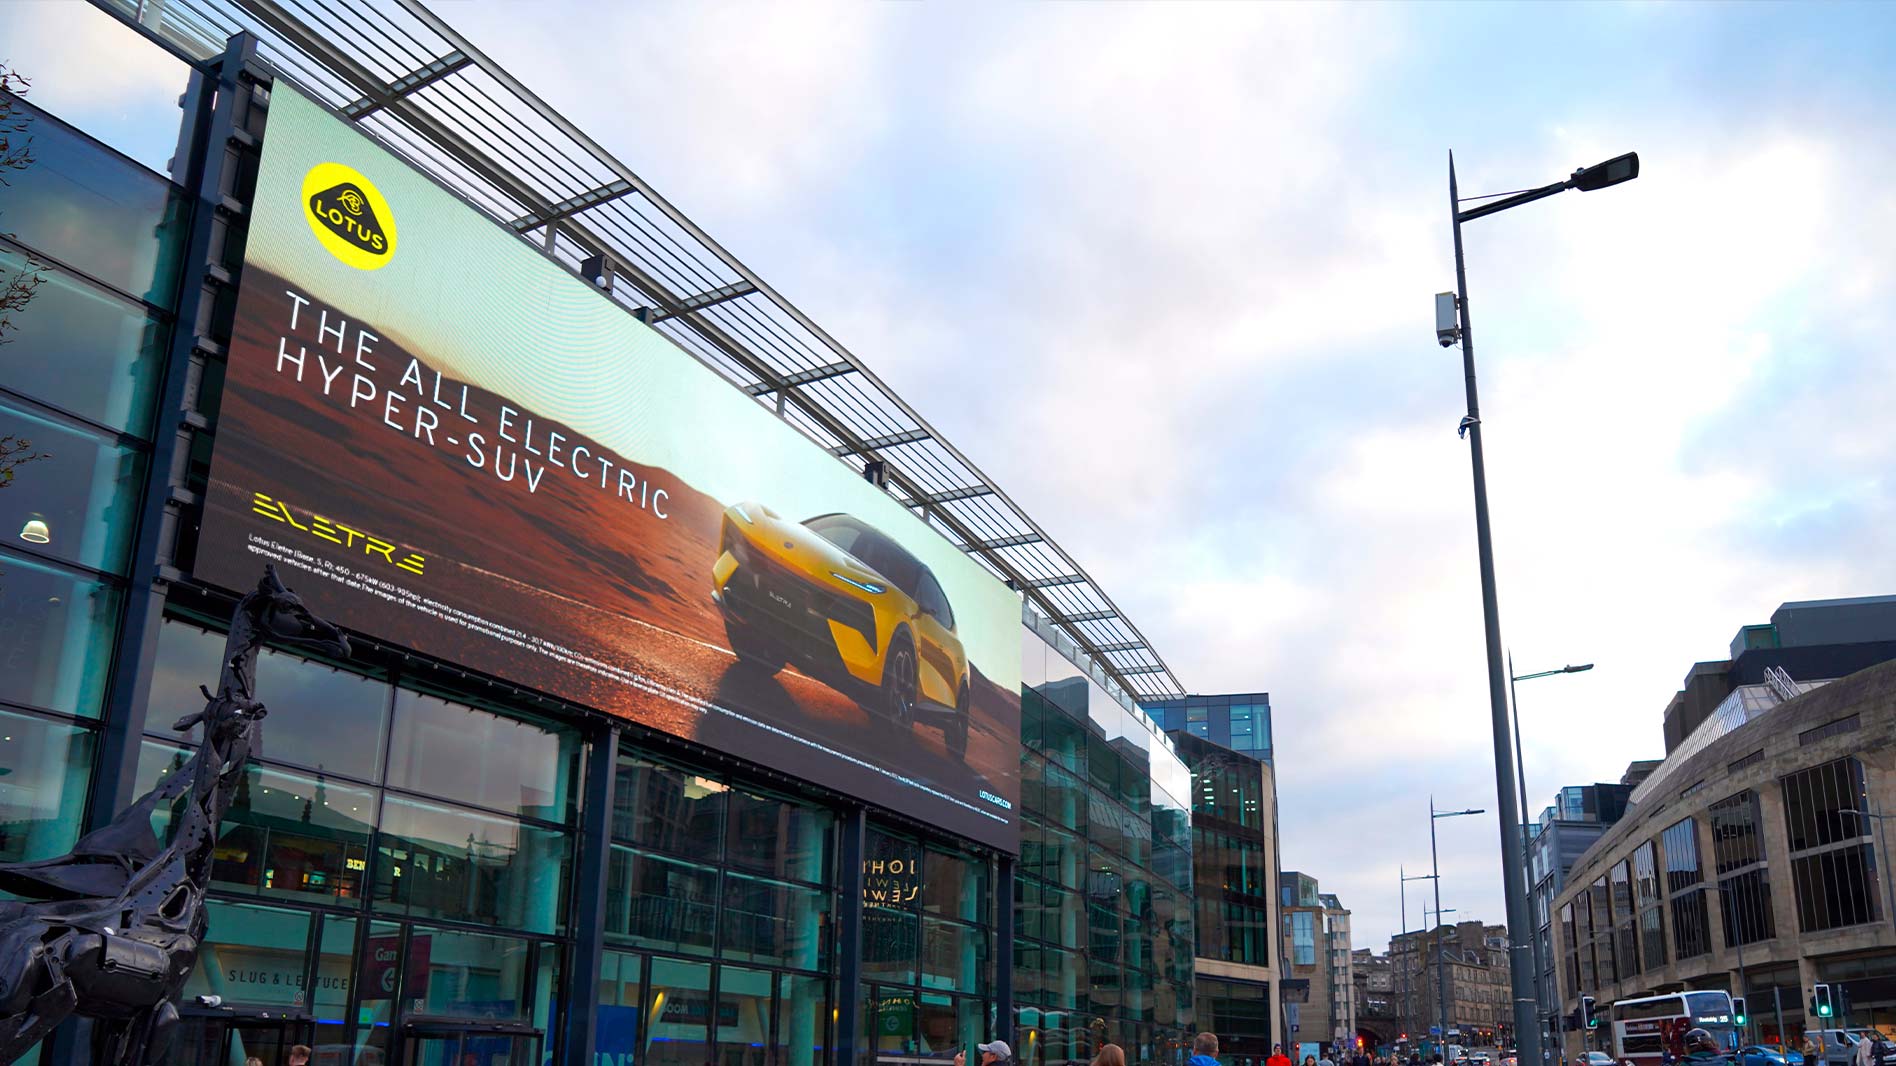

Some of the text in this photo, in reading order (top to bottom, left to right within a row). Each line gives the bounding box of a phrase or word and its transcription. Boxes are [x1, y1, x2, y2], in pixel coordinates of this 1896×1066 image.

[316, 199, 383, 250] LOTUS
[276, 337, 544, 493] HYPER-SUV
[286, 290, 669, 519] THE ALL ELECTRIC
[248, 531, 270, 546] Lotus
[270, 539, 293, 555] Eletre
[334, 563, 349, 576] 450
[252, 492, 425, 575] ELETRE
[247, 542, 282, 561] approved
[283, 555, 311, 571] vehicles
[312, 566, 330, 578] after
[330, 572, 344, 583] that
[374, 588, 397, 602] images
[398, 596, 404, 604] of
[405, 599, 416, 608] the
[416, 603, 437, 616] vehicle
[979, 789, 1012, 809] LOTUSCARS.COM
[228, 969, 349, 990] SLUG & LETUCE
